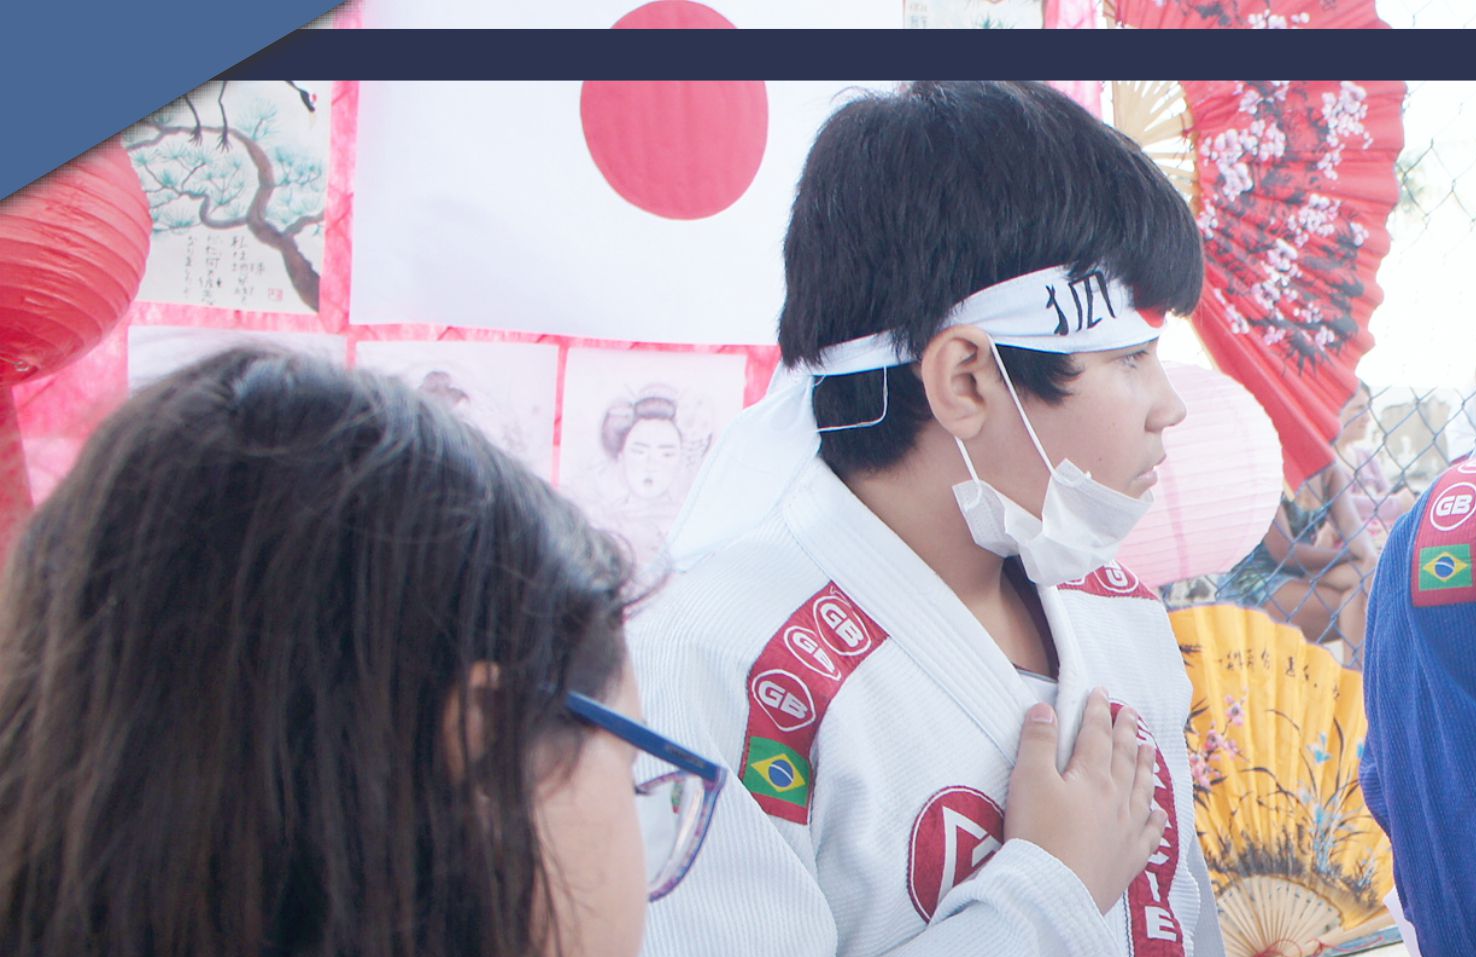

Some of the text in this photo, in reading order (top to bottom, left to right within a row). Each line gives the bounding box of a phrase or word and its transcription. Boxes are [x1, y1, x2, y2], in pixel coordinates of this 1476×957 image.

[1436, 495, 1473, 516] GB
[820, 603, 864, 648] GB
[758, 681, 808, 719] GB
